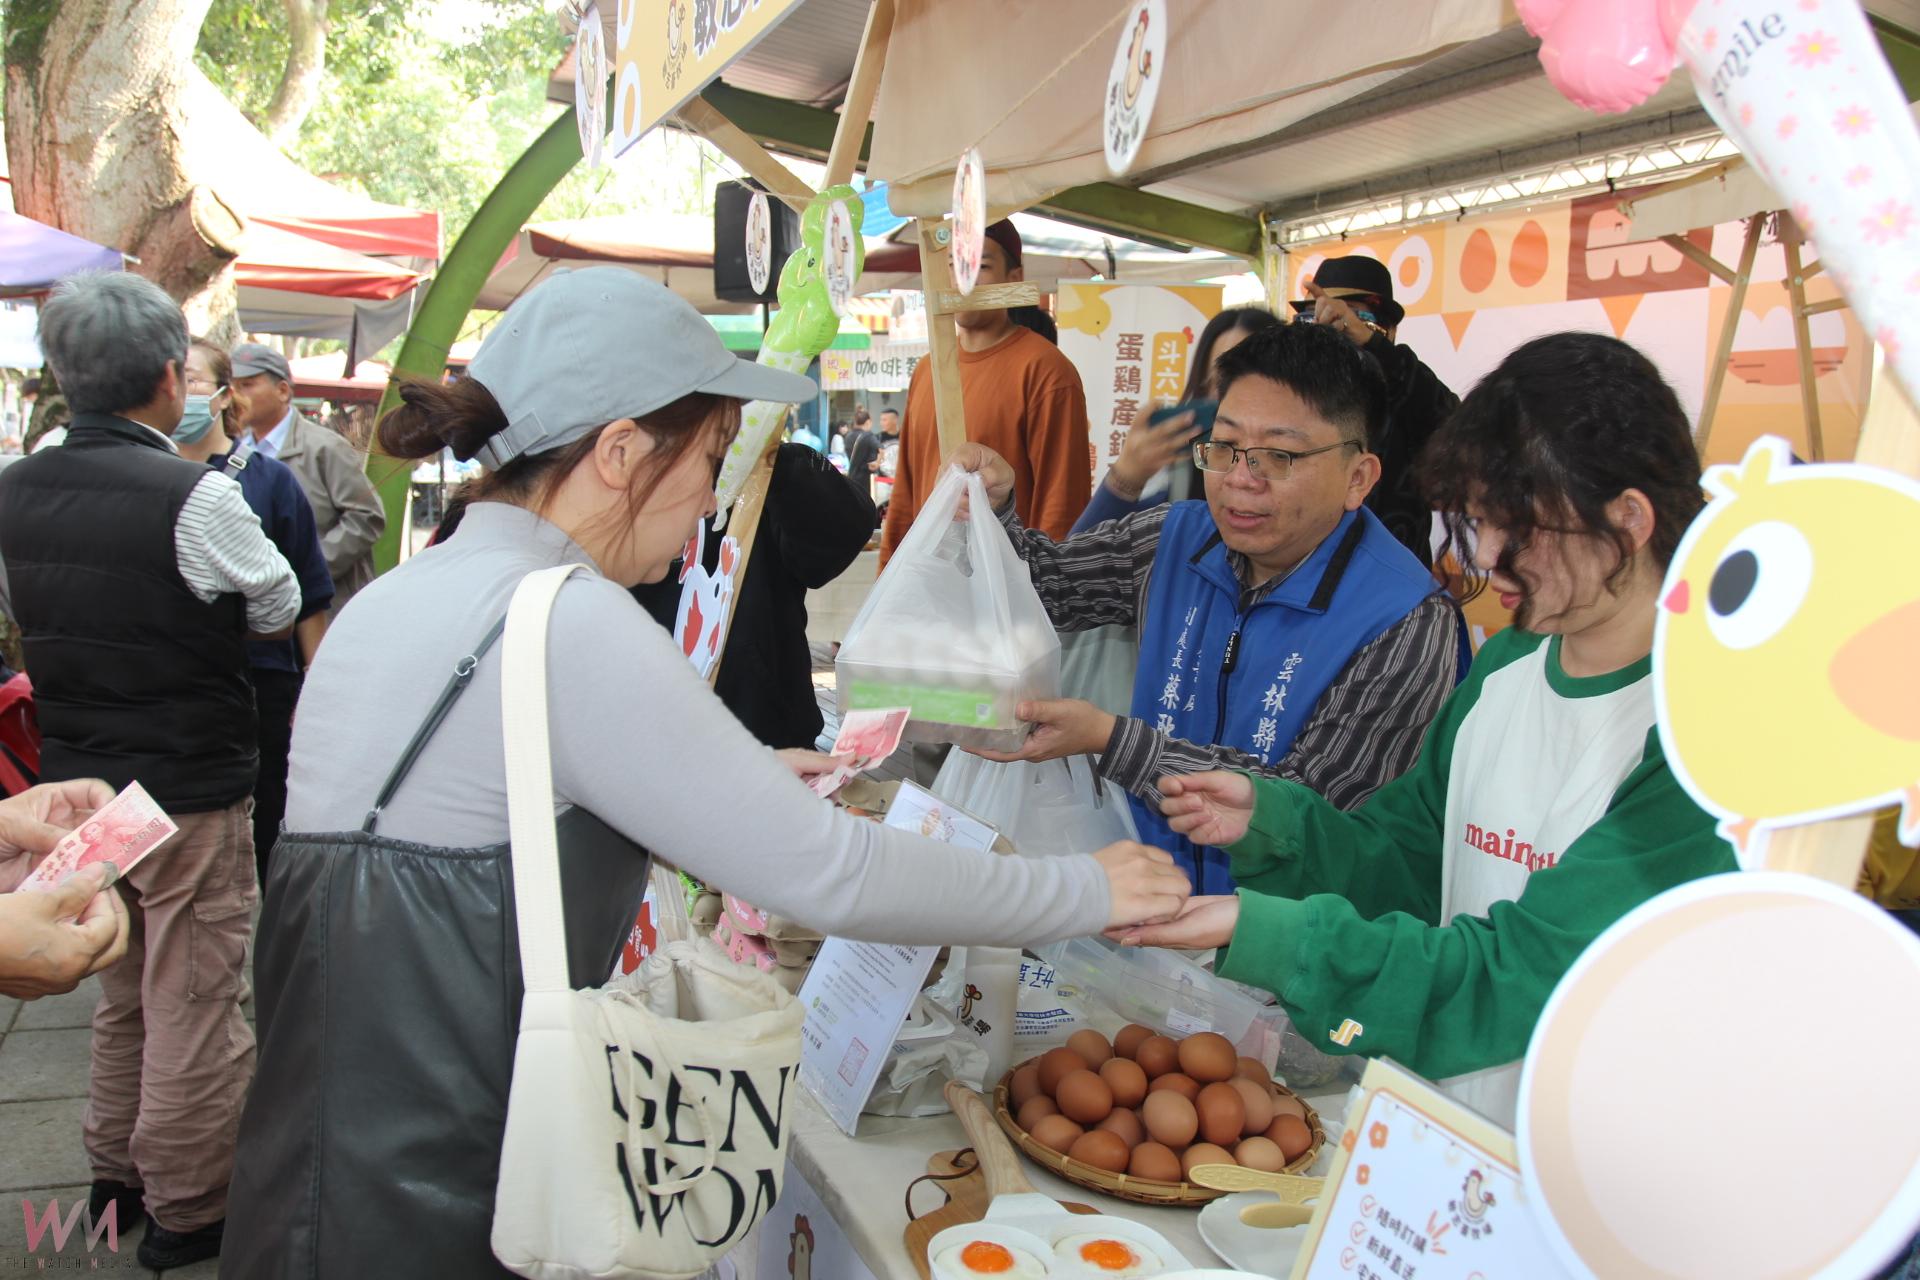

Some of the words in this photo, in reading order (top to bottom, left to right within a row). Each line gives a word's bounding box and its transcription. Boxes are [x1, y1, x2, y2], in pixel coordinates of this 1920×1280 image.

[1249, 653, 1303, 764] 雲林縣
[606, 1044, 800, 1152] GEN
